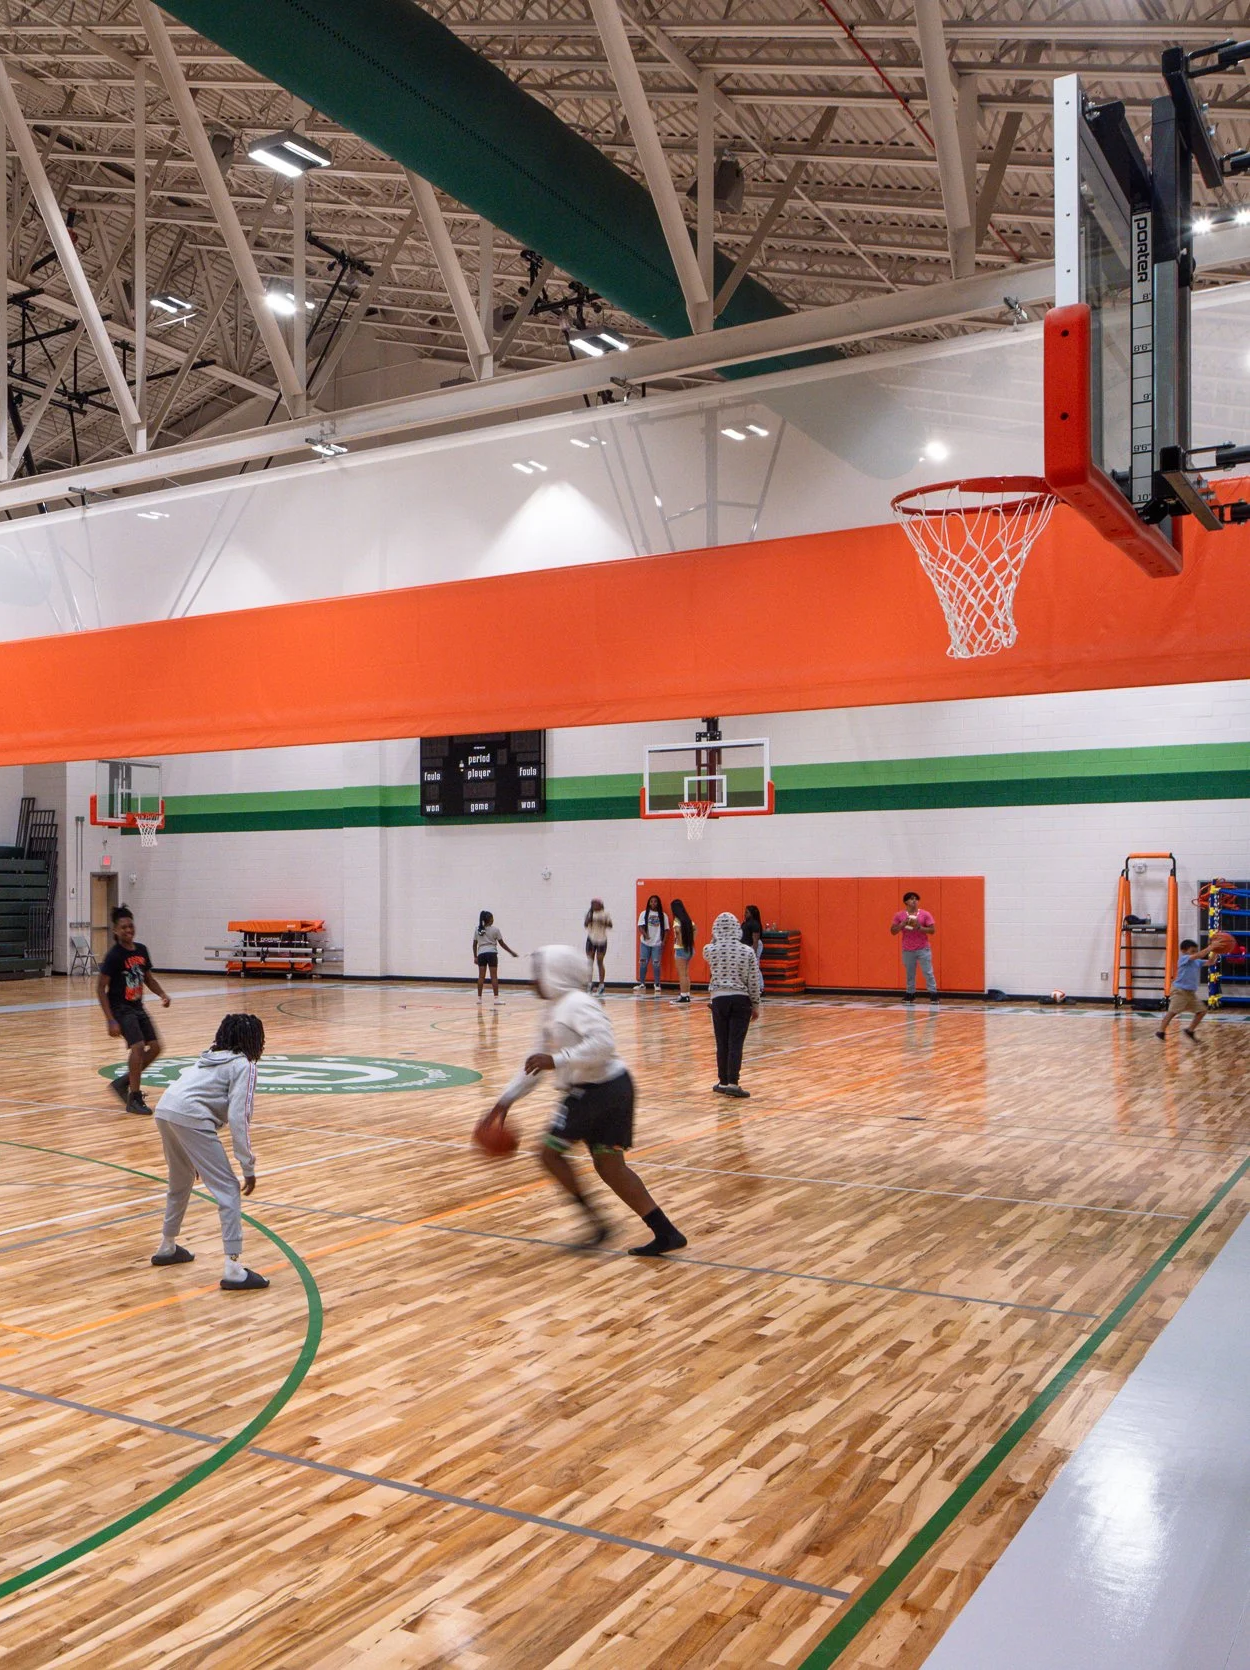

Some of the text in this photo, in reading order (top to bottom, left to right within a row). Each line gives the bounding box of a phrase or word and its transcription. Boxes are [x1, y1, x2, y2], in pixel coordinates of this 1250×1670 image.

[467, 753, 491, 765] period
[424, 771, 441, 781] fouls
[467, 768, 492, 780] player
[519, 766, 537, 776] fouls
[425, 804, 440, 812] won
[470, 802, 489, 813] game
[521, 800, 536, 809] won
